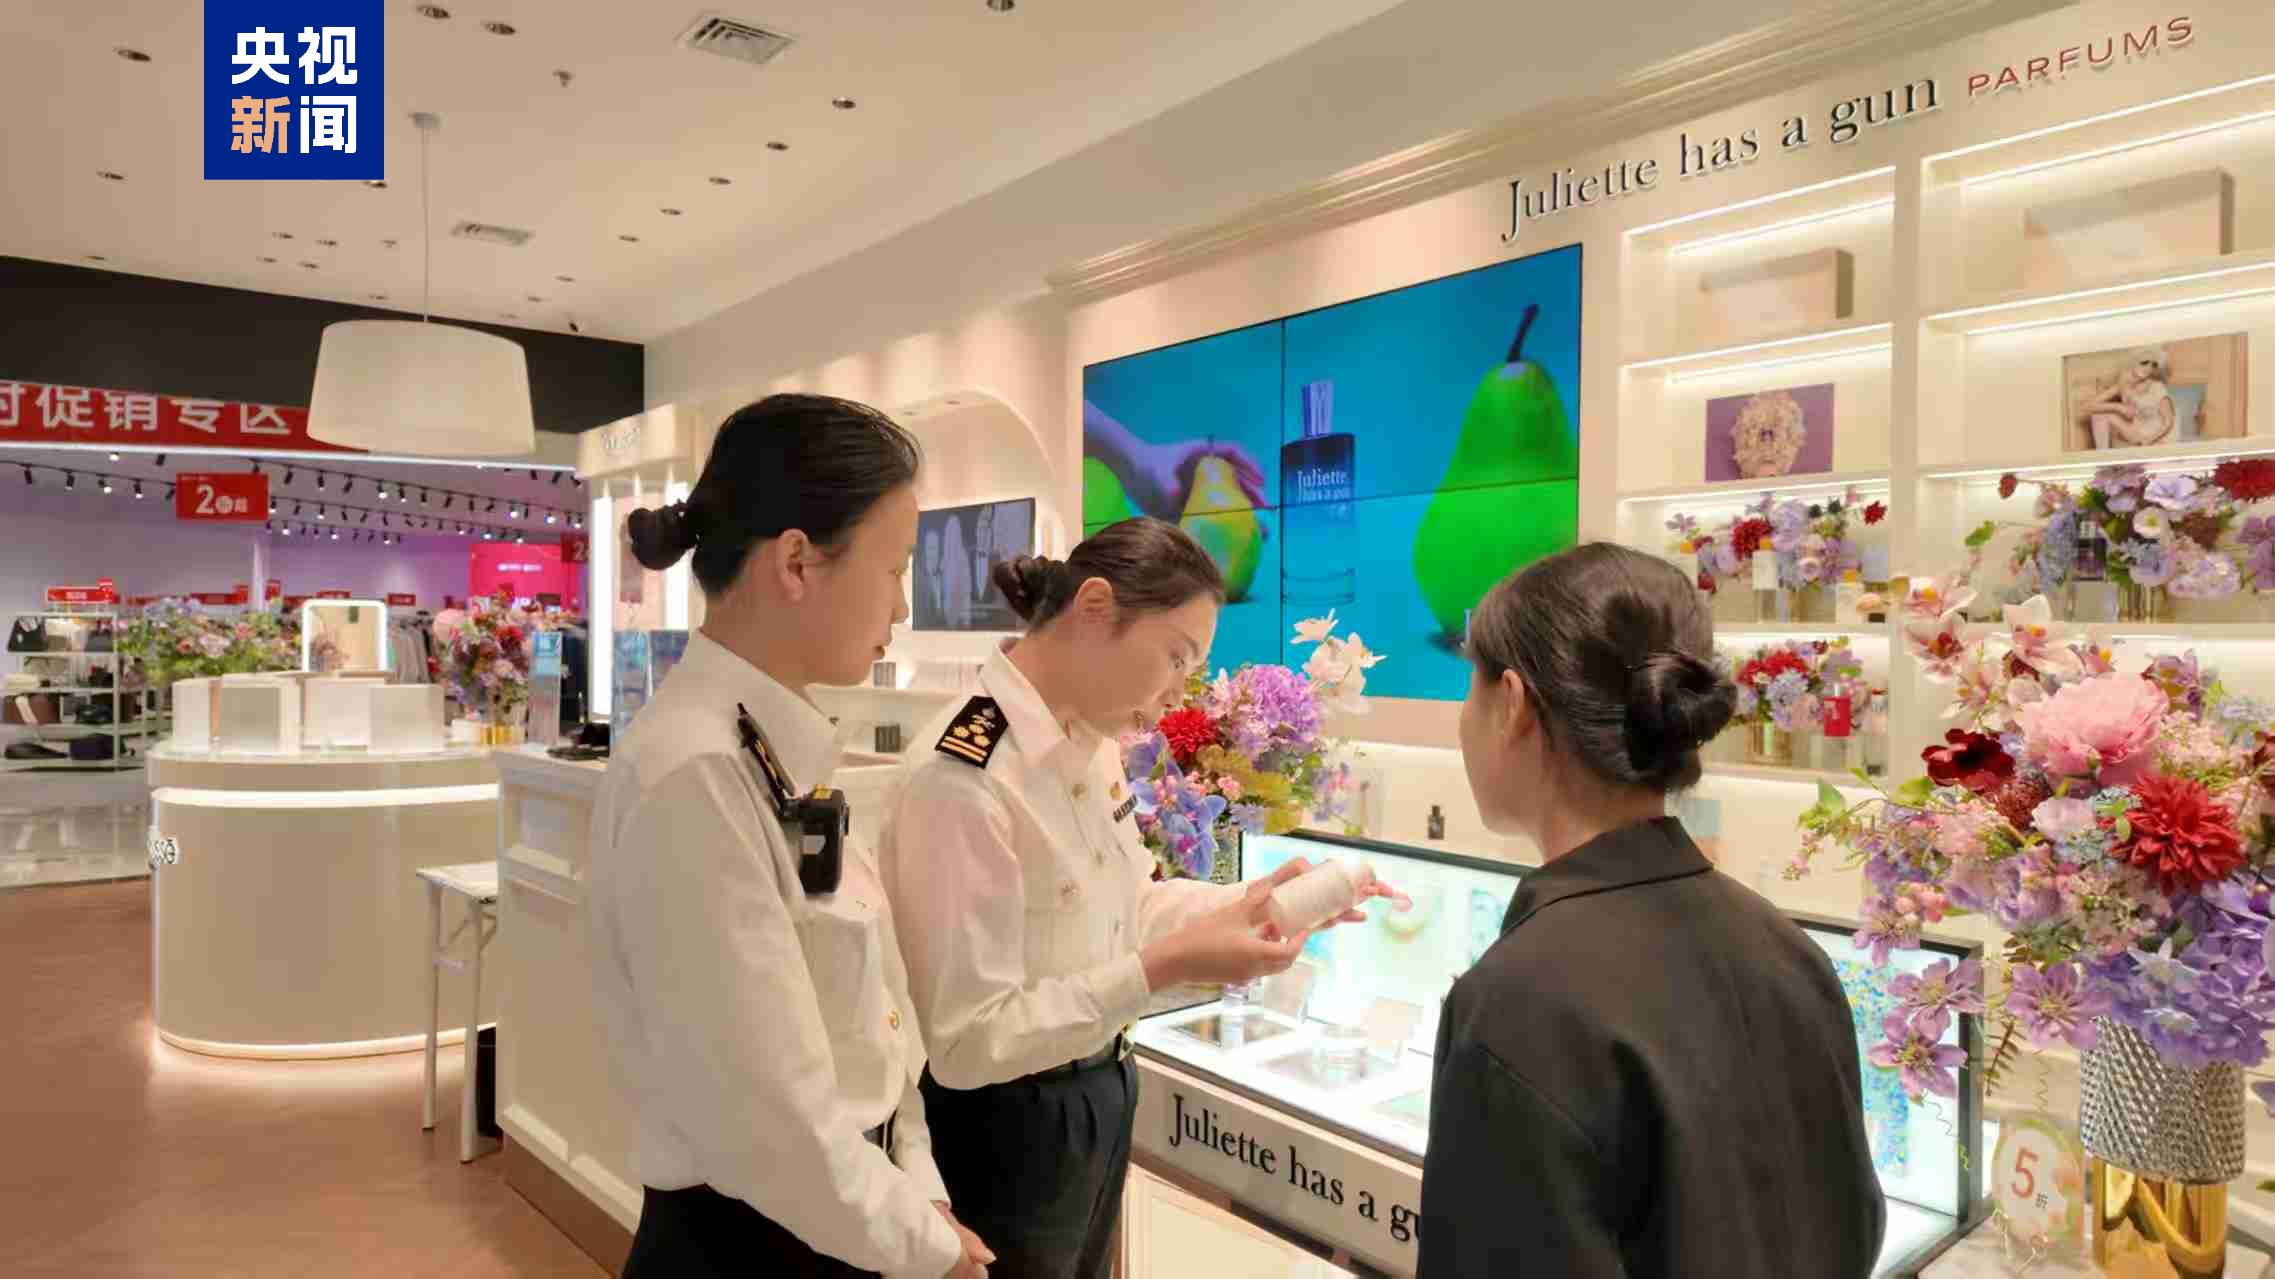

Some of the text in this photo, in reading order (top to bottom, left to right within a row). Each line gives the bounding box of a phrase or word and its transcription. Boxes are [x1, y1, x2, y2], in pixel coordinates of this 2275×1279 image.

[1967, 16, 2192, 97] PARFUMS
[1501, 78, 1938, 242] Juliette has a gun
[1169, 1093, 1277, 1174] Juliette
[1288, 1145, 1344, 1204] has
[1358, 1191, 1378, 1221] a
